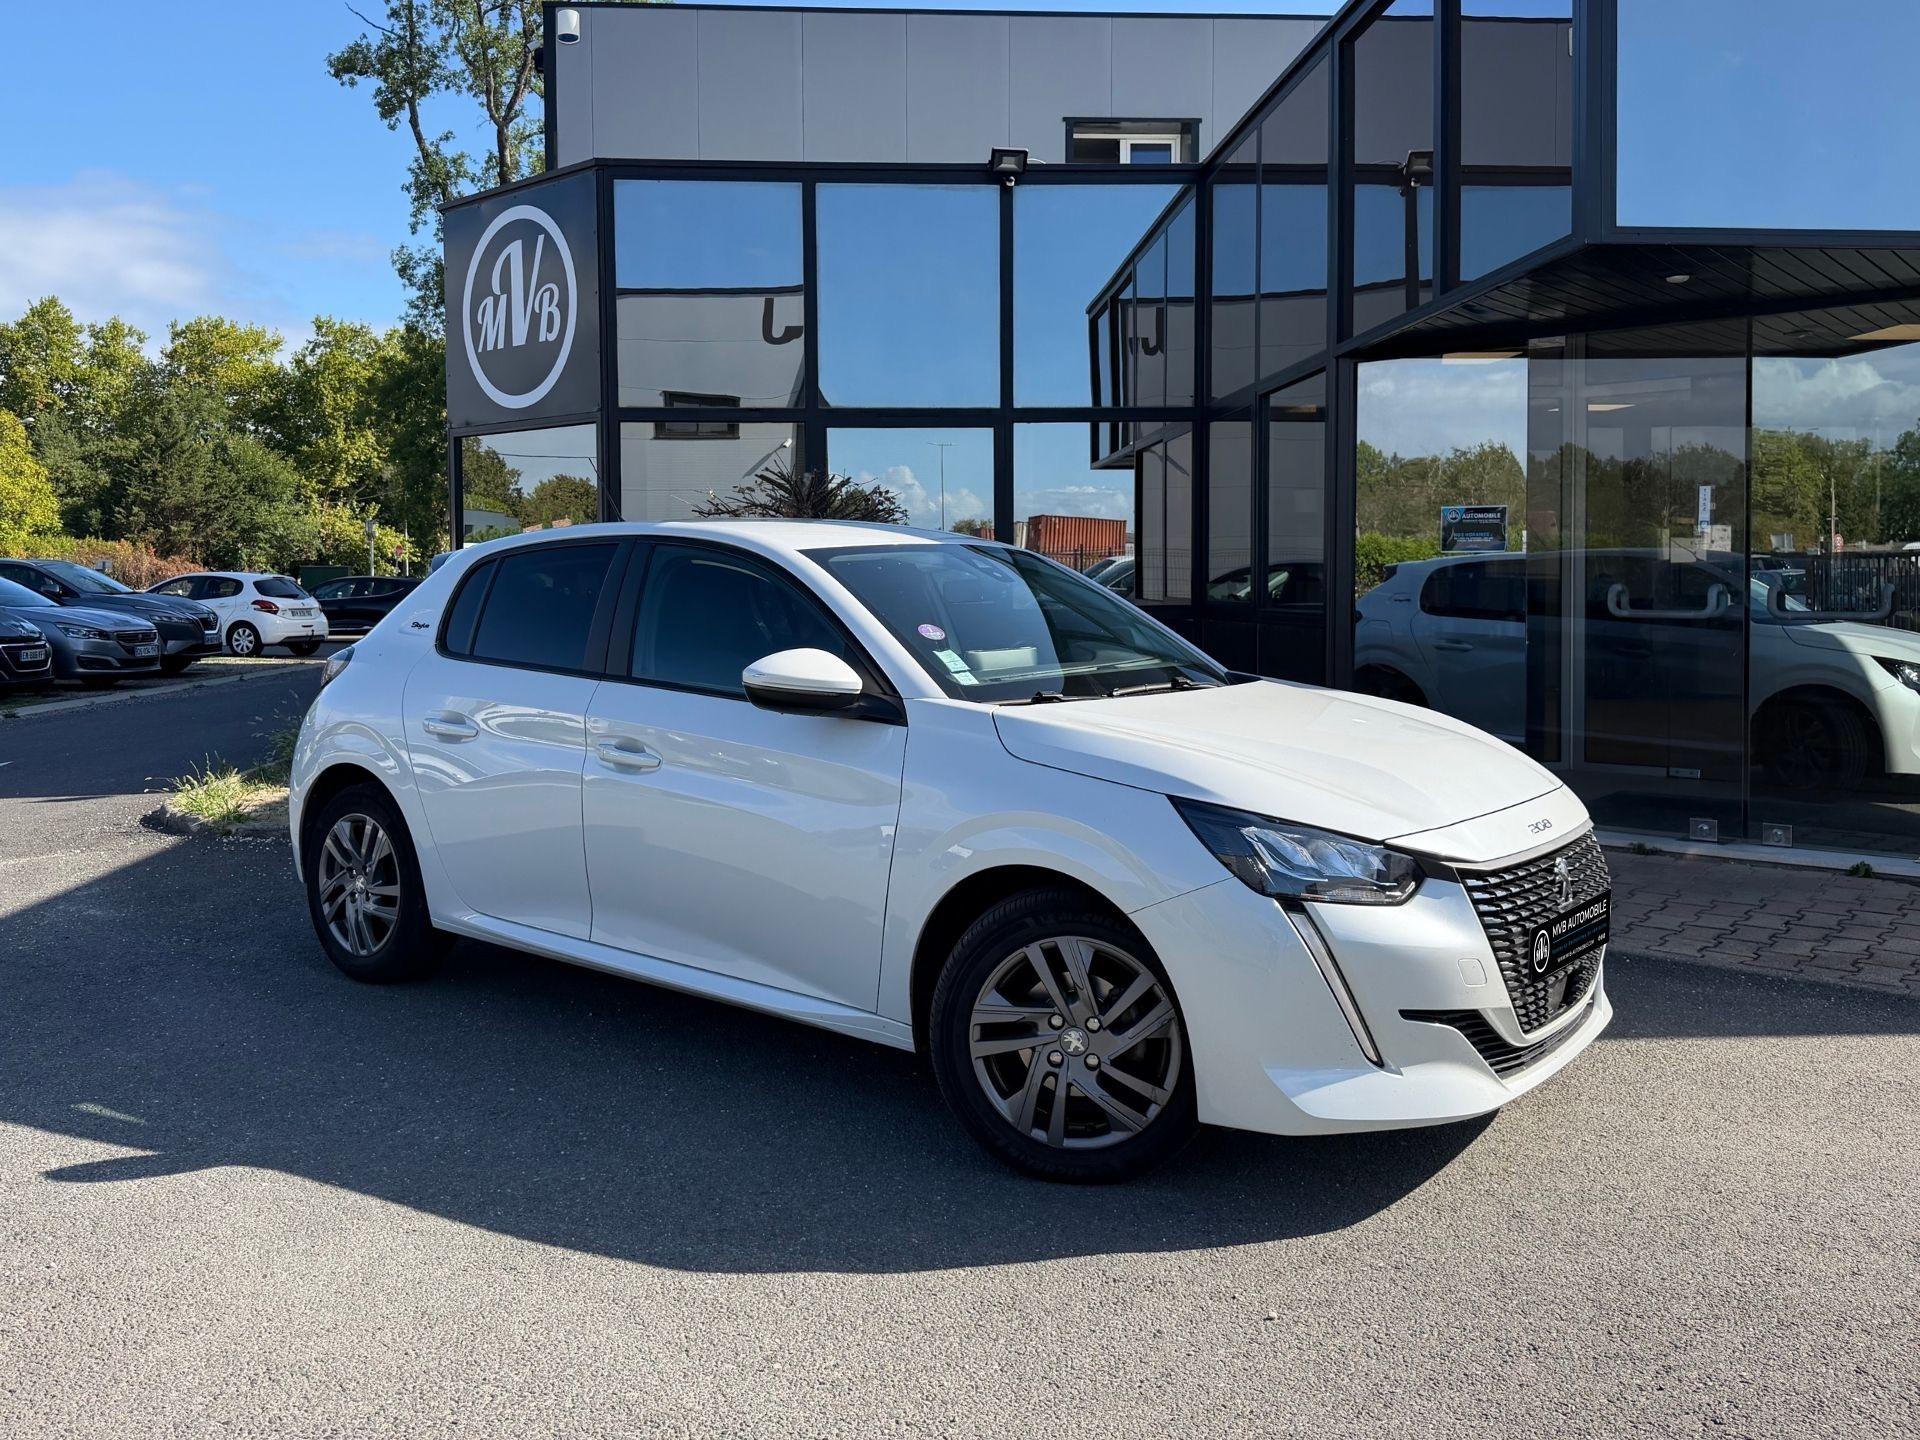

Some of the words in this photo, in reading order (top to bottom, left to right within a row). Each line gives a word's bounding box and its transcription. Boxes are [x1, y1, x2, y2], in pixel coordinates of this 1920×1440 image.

[477, 233, 561, 353] MVB
[1527, 818, 1553, 834] 208
[1552, 920, 1567, 938] MVB
[1567, 899, 1607, 930] AUTOMOBILE
